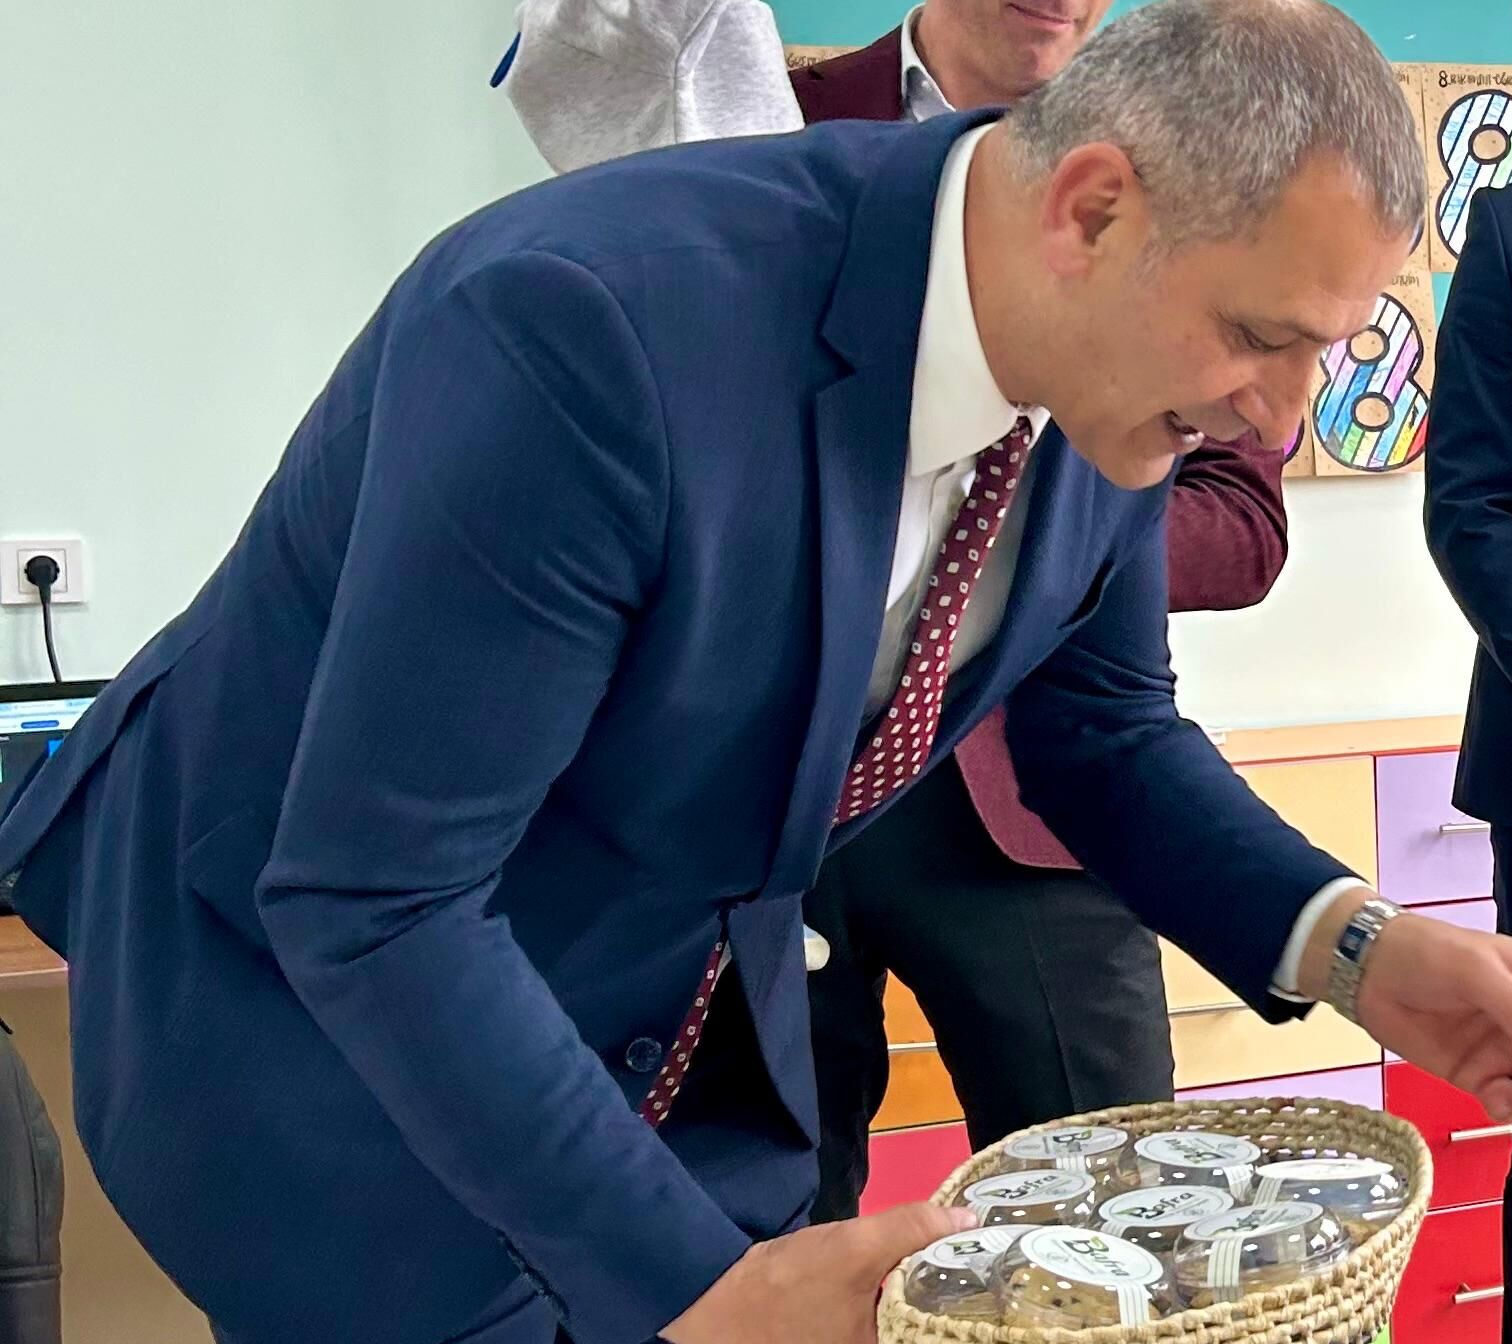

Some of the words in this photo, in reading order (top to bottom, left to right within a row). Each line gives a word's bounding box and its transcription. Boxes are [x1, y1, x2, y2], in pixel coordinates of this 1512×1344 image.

[993, 1173, 1057, 1200] Bafra
[1128, 1191, 1195, 1220] Bafra
[1062, 1236, 1130, 1277] Bafra
